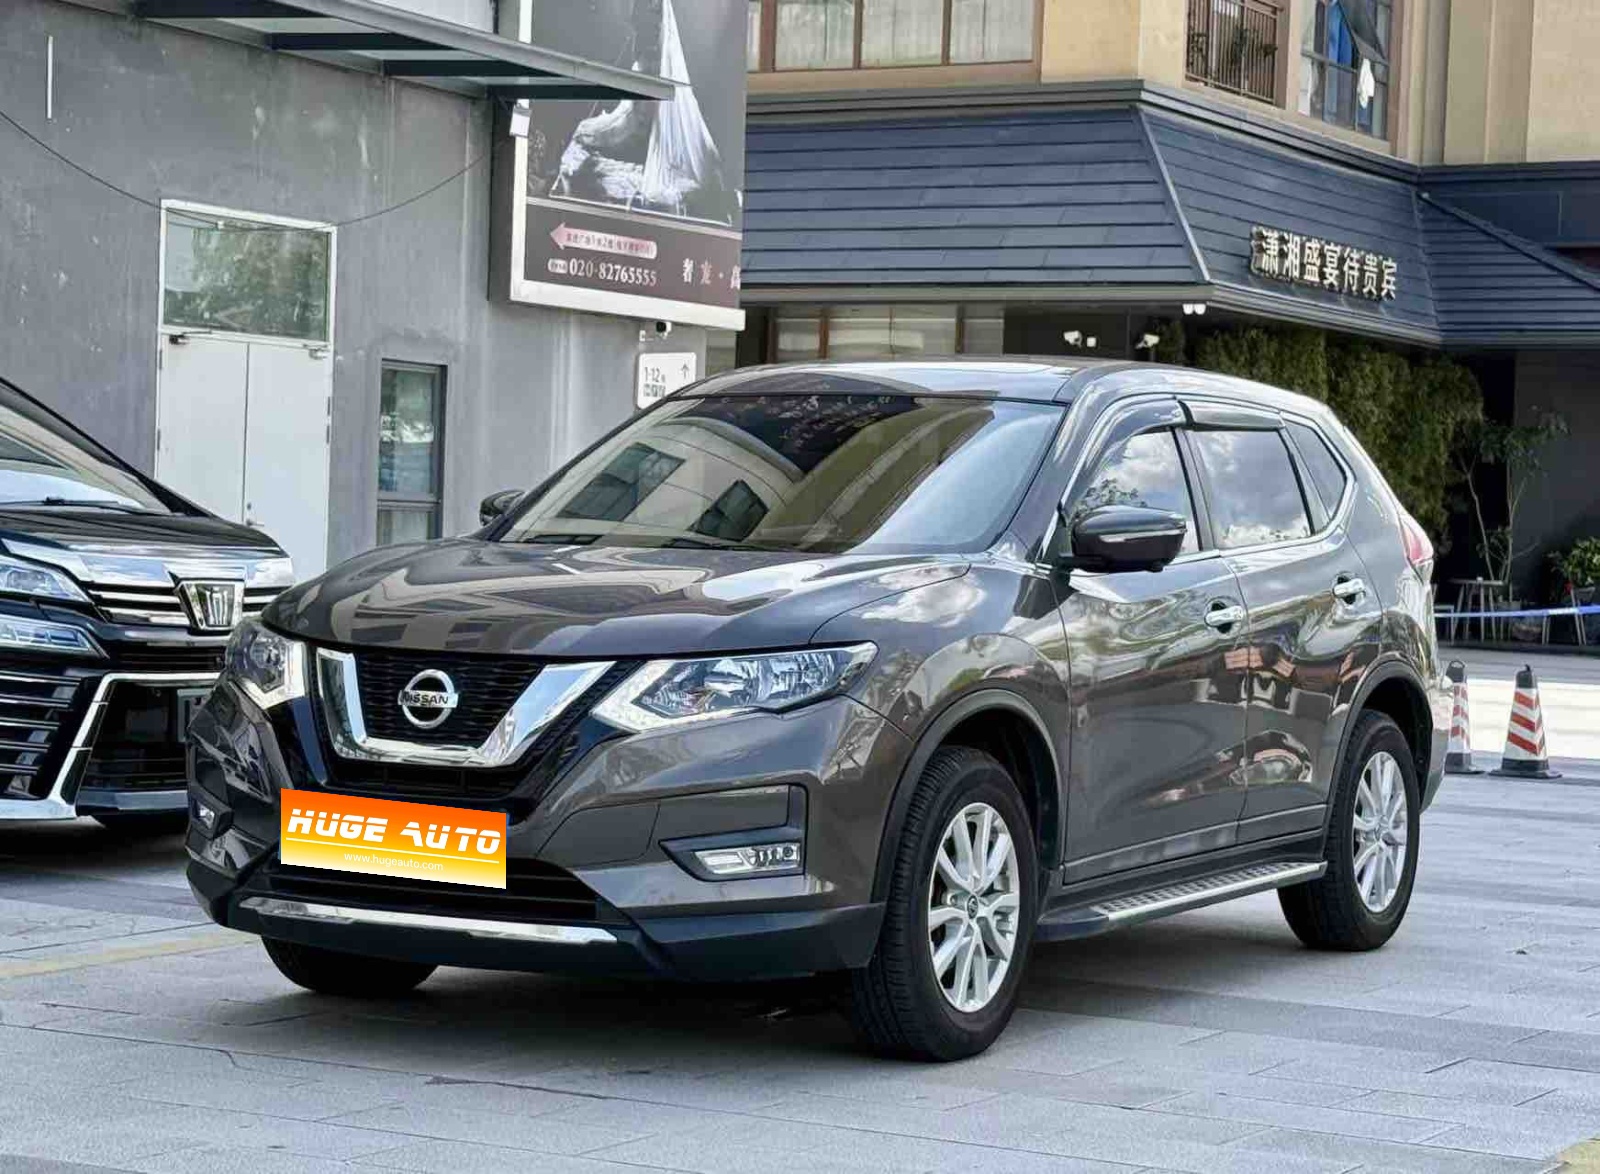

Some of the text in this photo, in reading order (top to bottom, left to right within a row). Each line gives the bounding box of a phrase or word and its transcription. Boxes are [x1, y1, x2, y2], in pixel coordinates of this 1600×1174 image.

[569, 258, 657, 286] 020-82765555
[1260, 227, 1398, 300] 潇湘盛宴待贵宾
[400, 691, 449, 706] NISSAN
